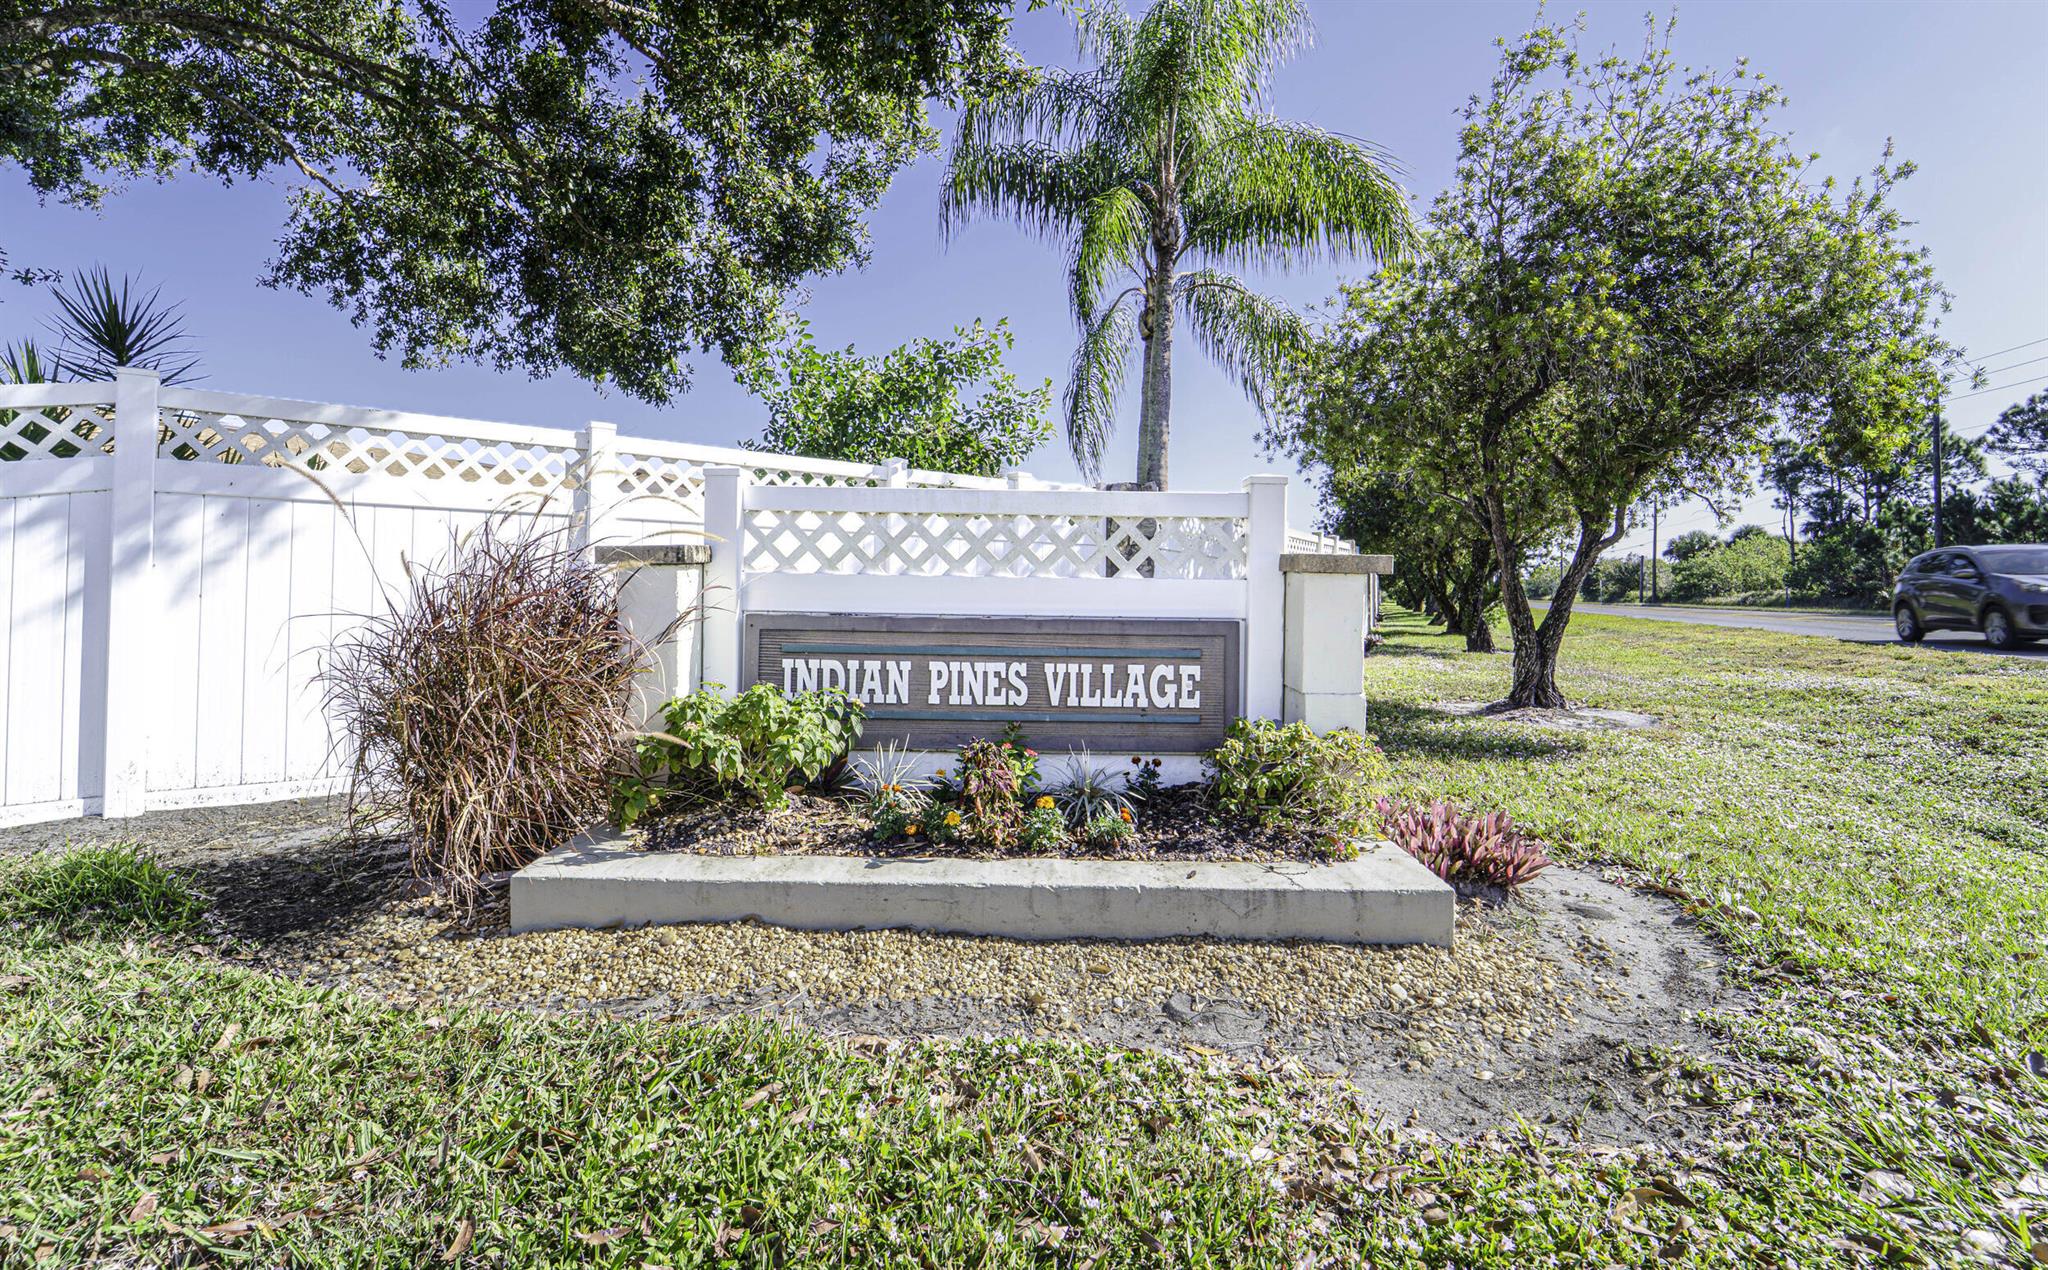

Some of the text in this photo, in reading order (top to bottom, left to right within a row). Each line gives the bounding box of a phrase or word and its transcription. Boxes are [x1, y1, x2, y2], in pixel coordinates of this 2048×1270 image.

[781, 658, 1201, 709] INDIAN PINES VILLAGE
